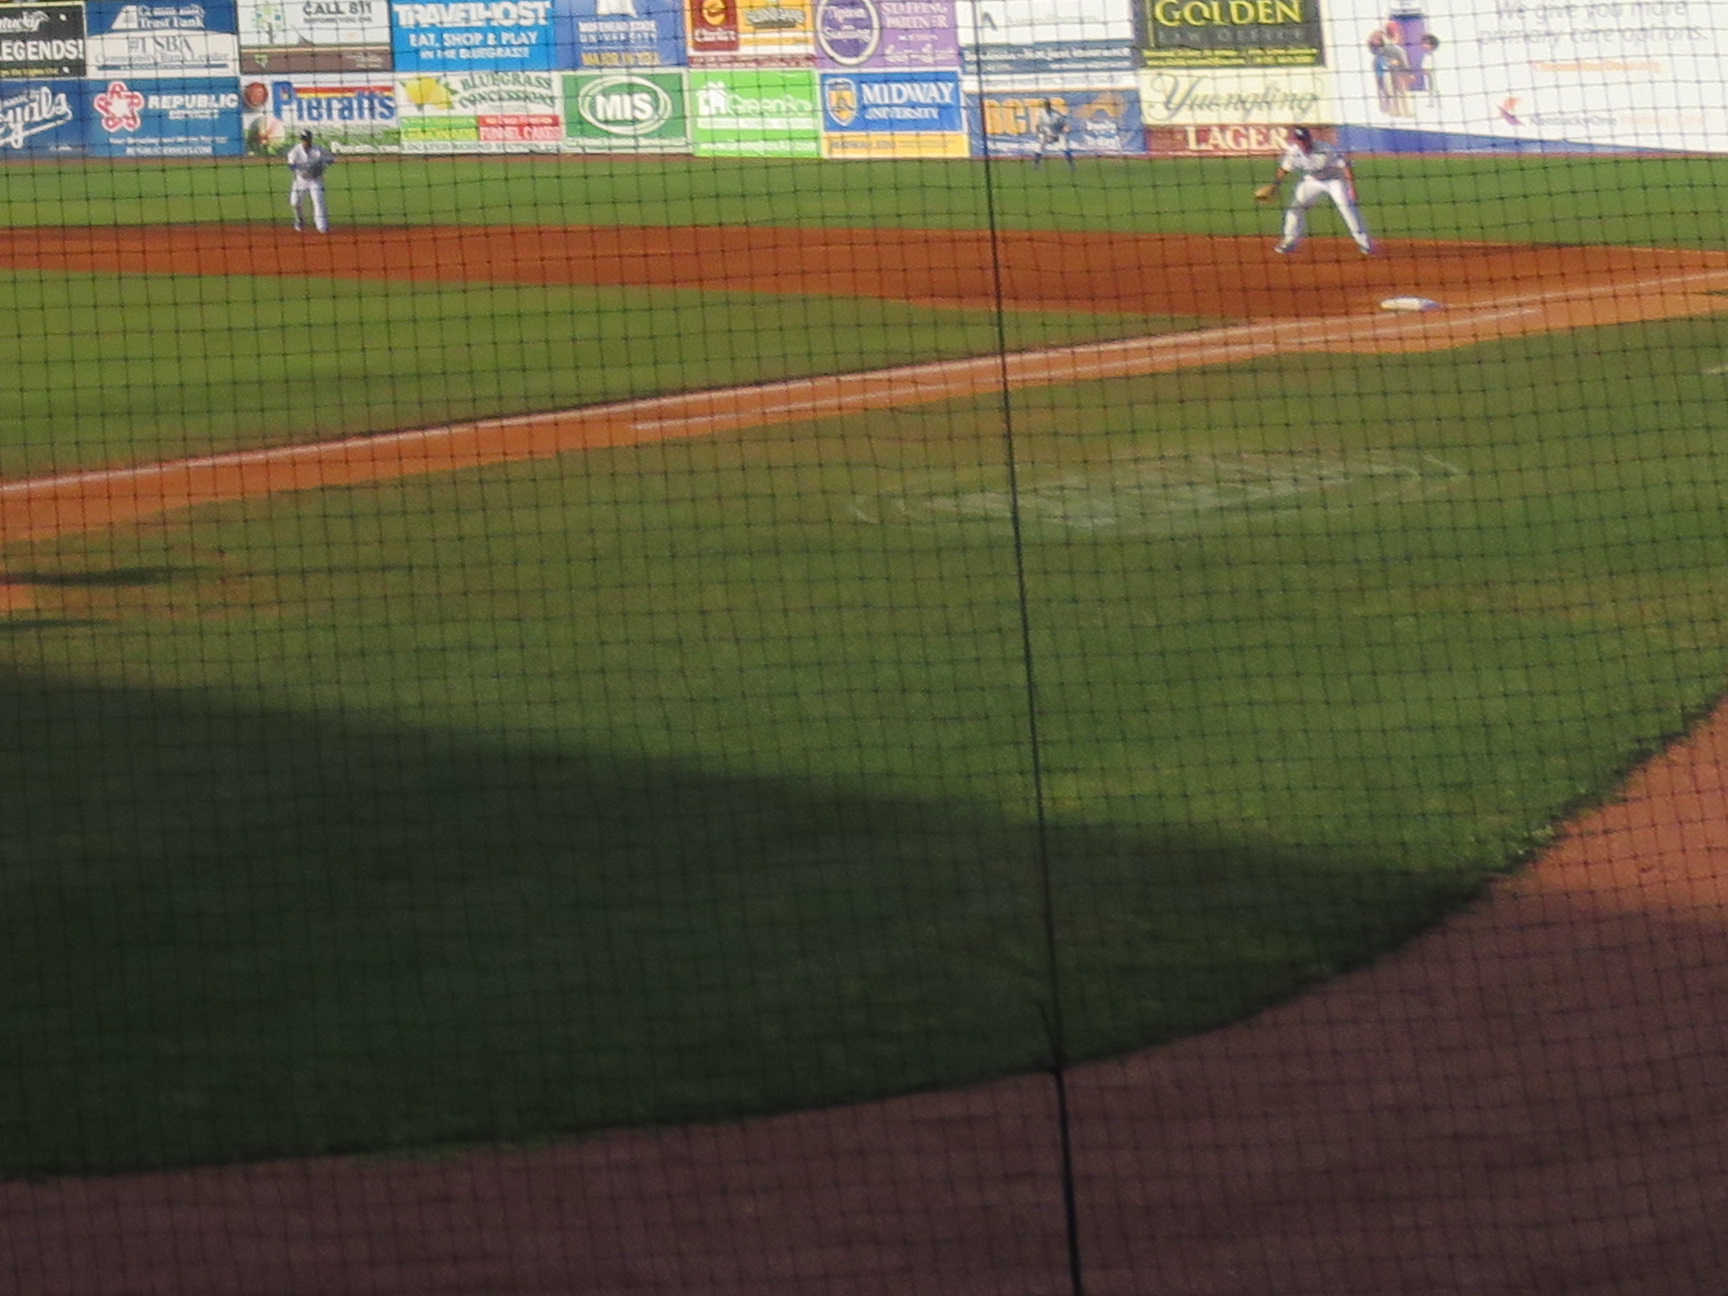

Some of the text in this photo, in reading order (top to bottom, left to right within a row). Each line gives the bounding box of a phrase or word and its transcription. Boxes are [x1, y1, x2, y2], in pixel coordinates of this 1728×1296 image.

[302, 0, 373, 16] CALL 811
[393, 0, 552, 28] TRAVELHOST
[1497, 0, 1688, 24] We give you more
[885, 14, 949, 29] PARTNER
[153, 35, 195, 55] SBA
[442, 31, 483, 46] SHOP
[500, 30, 538, 45] PLAY
[460, 72, 553, 91] BLUEGRASS
[860, 80, 956, 105] MIDWAY
[147, 93, 239, 109] REPUBLIC
[594, 92, 654, 121] MIS
[1147, 73, 1324, 122] Yuengling
[1184, 125, 1291, 151] LAGER
